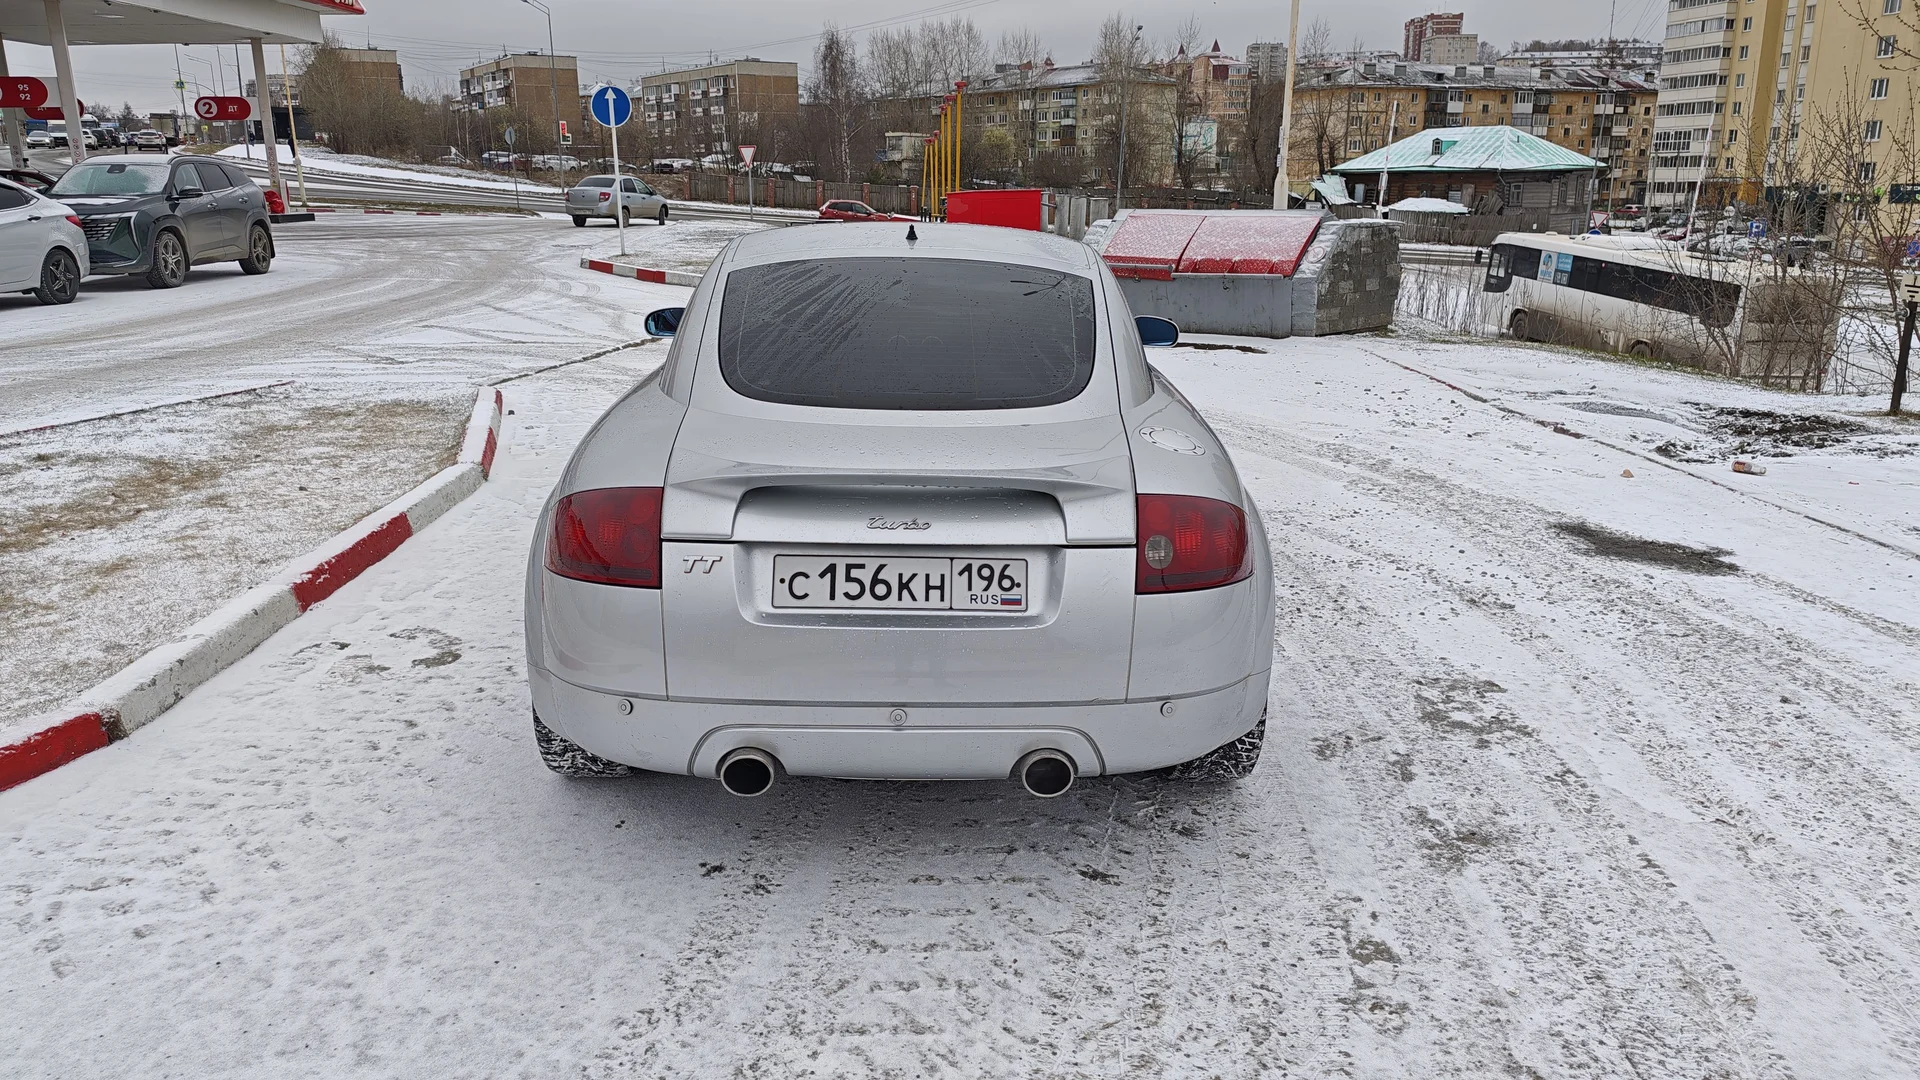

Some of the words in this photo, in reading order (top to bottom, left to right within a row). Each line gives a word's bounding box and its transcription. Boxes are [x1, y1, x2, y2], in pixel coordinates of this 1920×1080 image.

[19, 93, 31, 101] 92
[202, 101, 214, 115] 2
[228, 105, 238, 113] ДТ
[867, 515, 932, 531] turbo
[682, 555, 722, 574] TT
[957, 562, 1016, 592] 196
[970, 593, 999, 605] RUS
